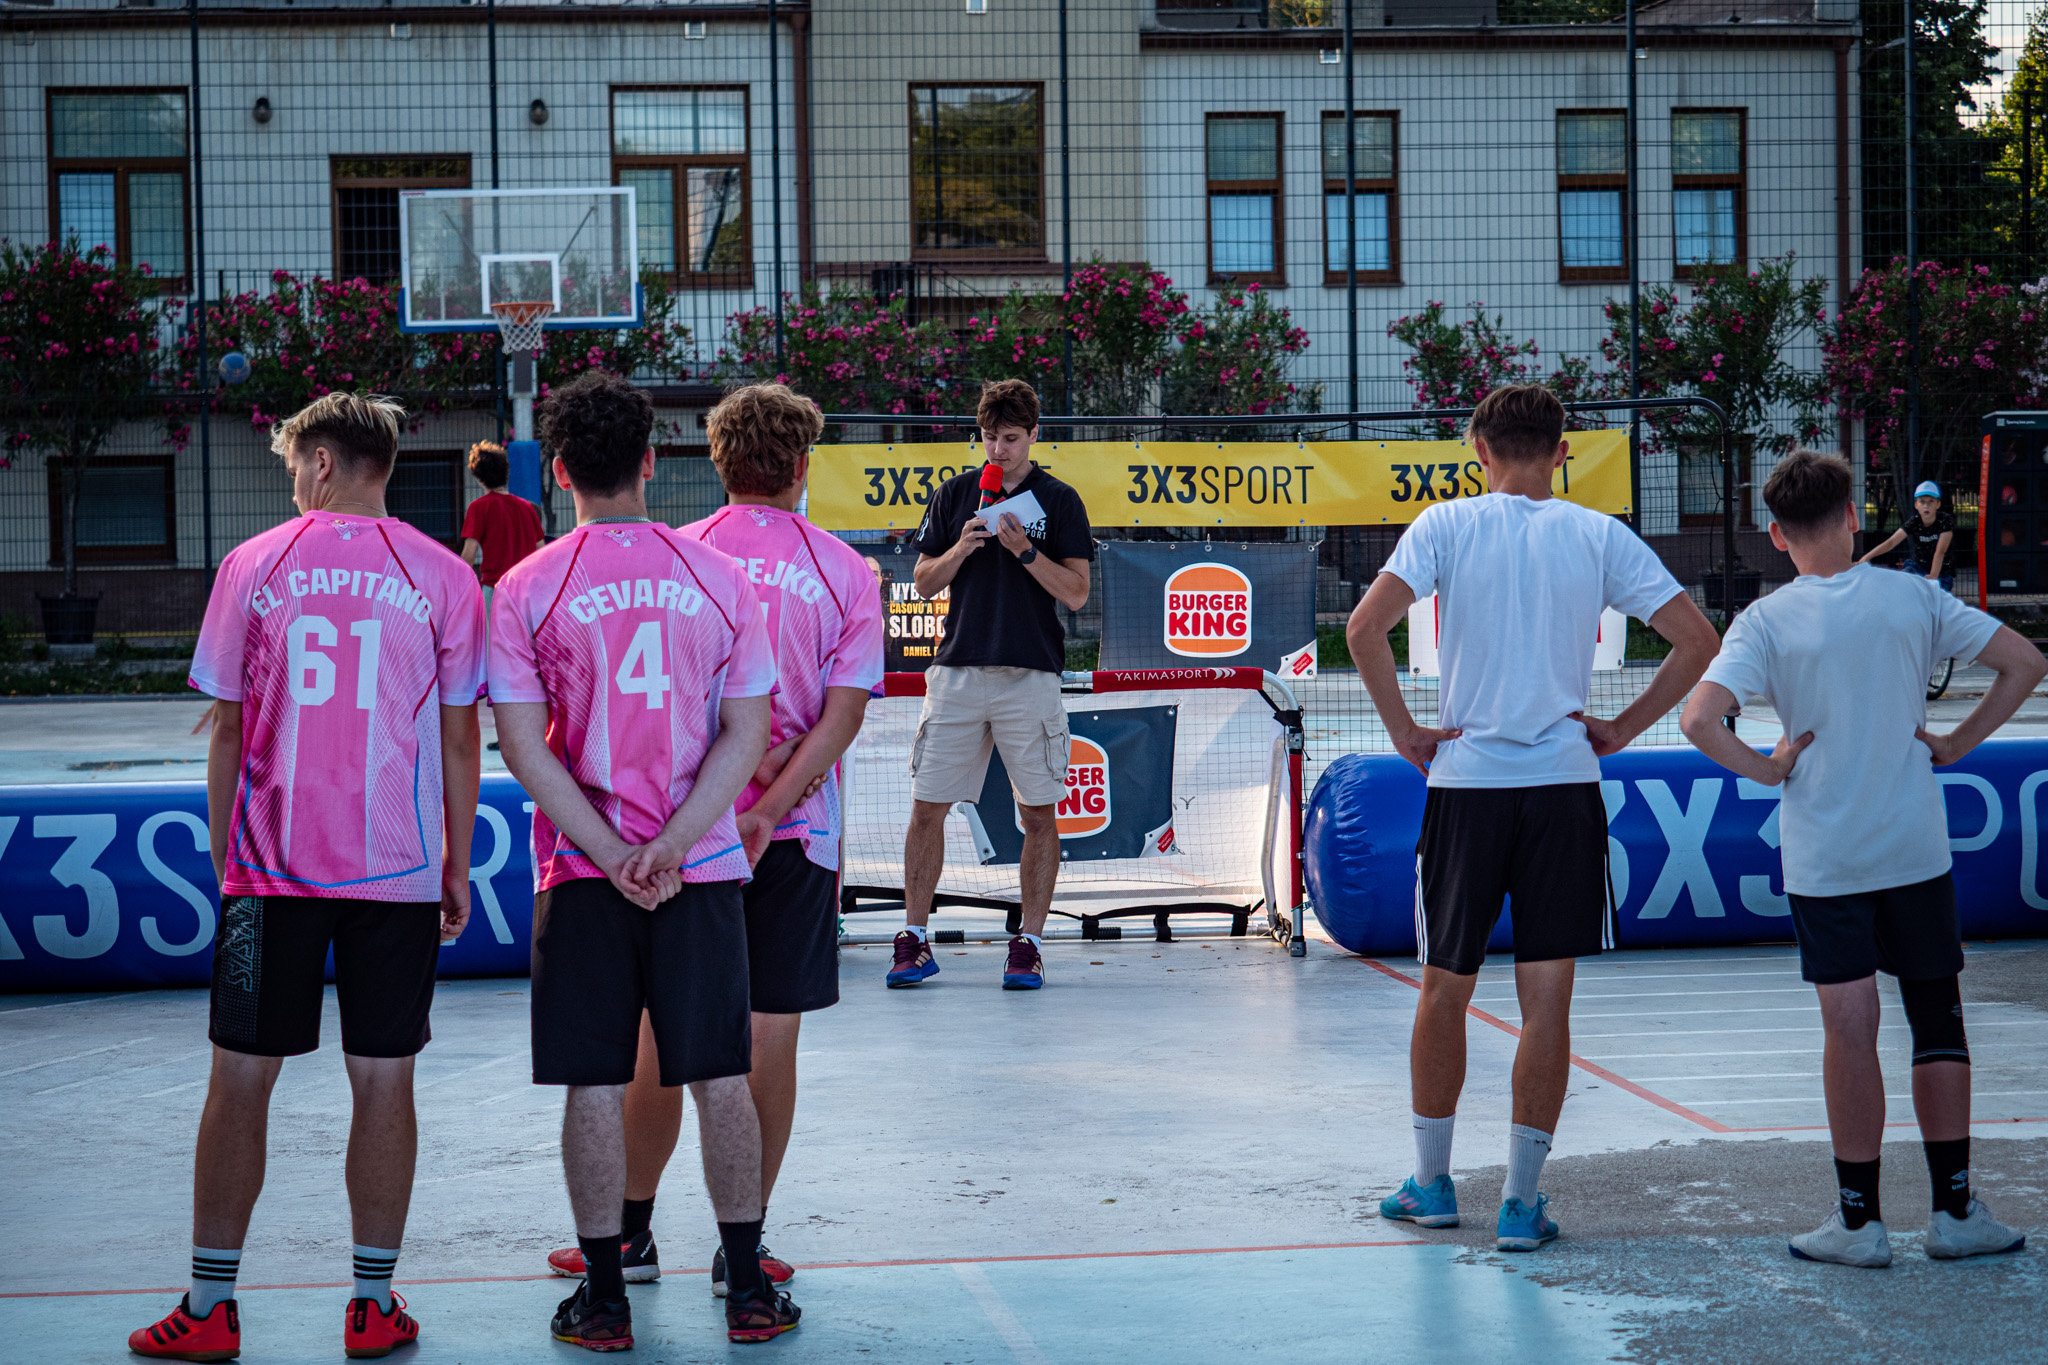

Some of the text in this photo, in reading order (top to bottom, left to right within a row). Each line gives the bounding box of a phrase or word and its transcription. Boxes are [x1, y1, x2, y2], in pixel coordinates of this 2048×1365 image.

[1127, 464, 1315, 505] 3X3SPORT
[1025, 528, 1047, 540] PORT
[251, 568, 433, 624] EL CAPITANO
[568, 579, 704, 624] CEVARO
[889, 600, 924, 615] ČASOVÚ
[926, 602, 933, 614] A
[1168, 593, 1248, 611] BURGER
[1168, 611, 1248, 637] KING
[287, 615, 382, 710] 61
[903, 646, 932, 657] DANIEL
[615, 621, 671, 710] 4
[1114, 669, 1211, 682] YAKIMASPORT
[1064, 766, 1105, 787] GER
[1057, 787, 1106, 816] NG
